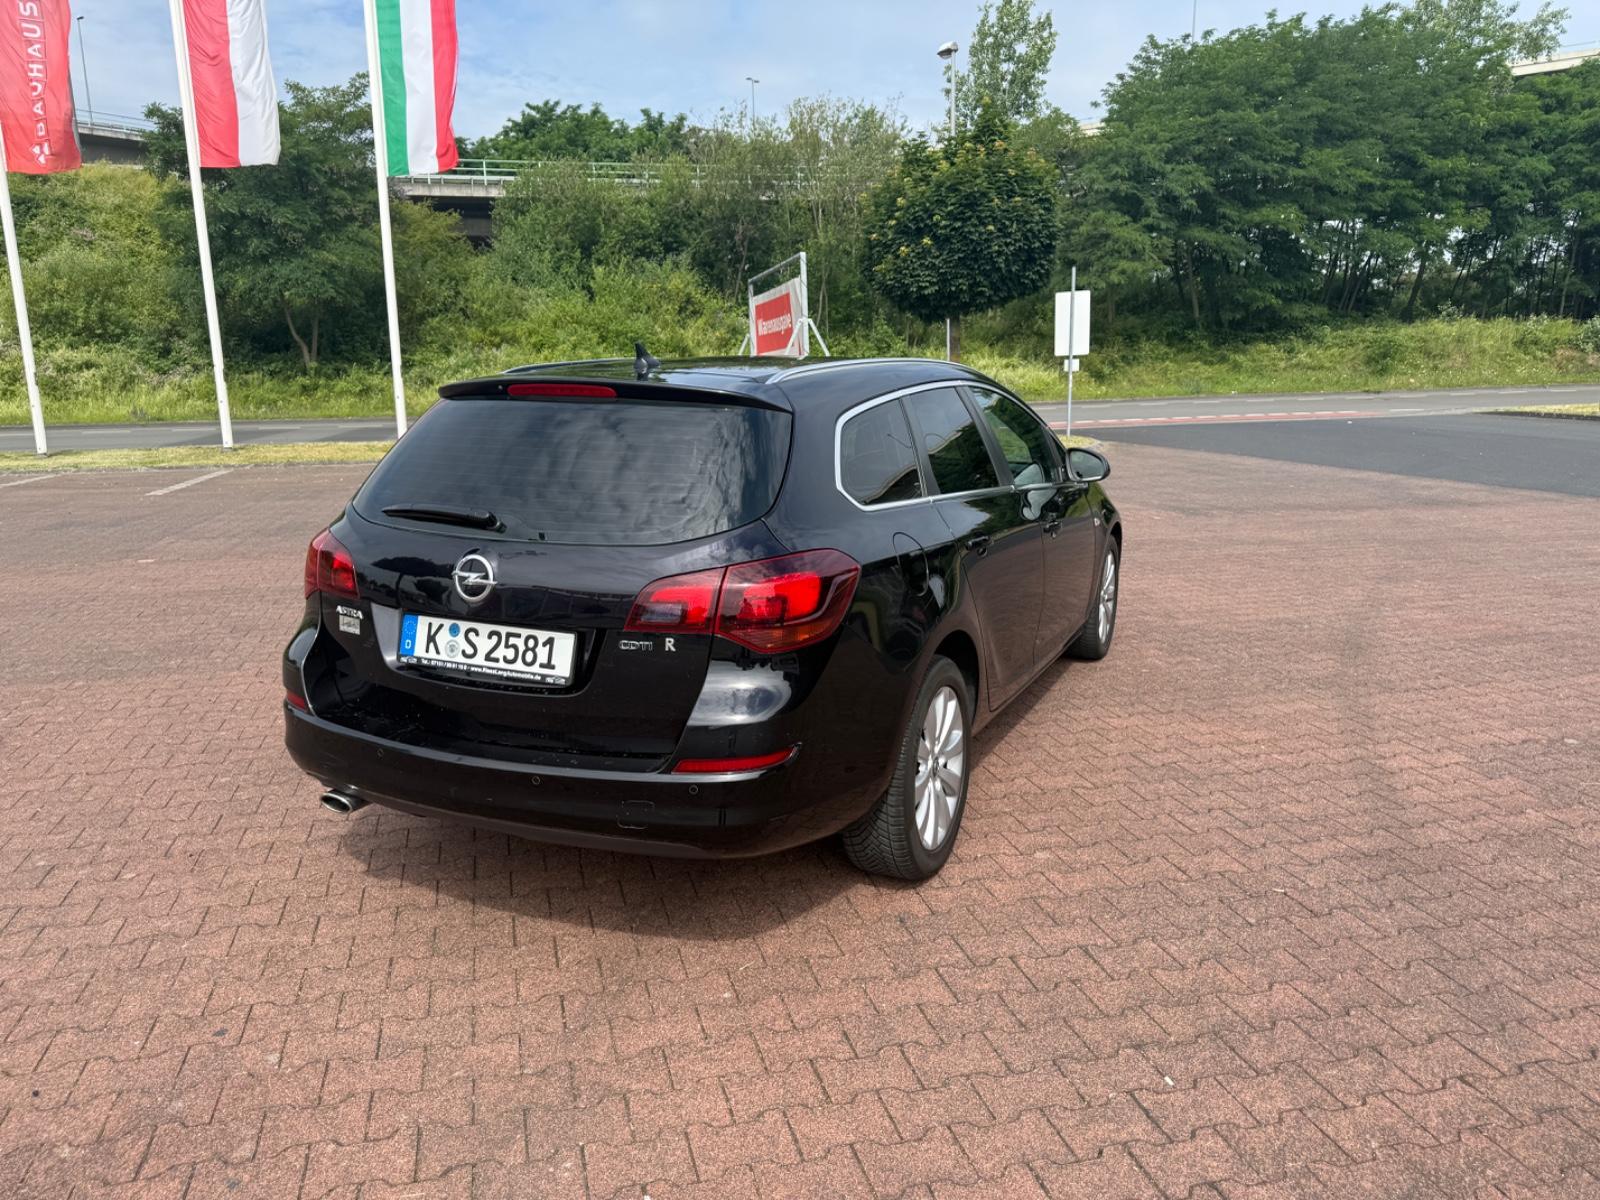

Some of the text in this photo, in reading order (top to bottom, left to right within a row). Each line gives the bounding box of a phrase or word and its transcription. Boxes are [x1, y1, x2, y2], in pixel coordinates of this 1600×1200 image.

[18, 0, 46, 137] BAUHAUS
[336, 605, 363, 619] ASTRA
[405, 639, 412, 649] D
[425, 622, 556, 670] K S 2581
[665, 637, 676, 651] R
